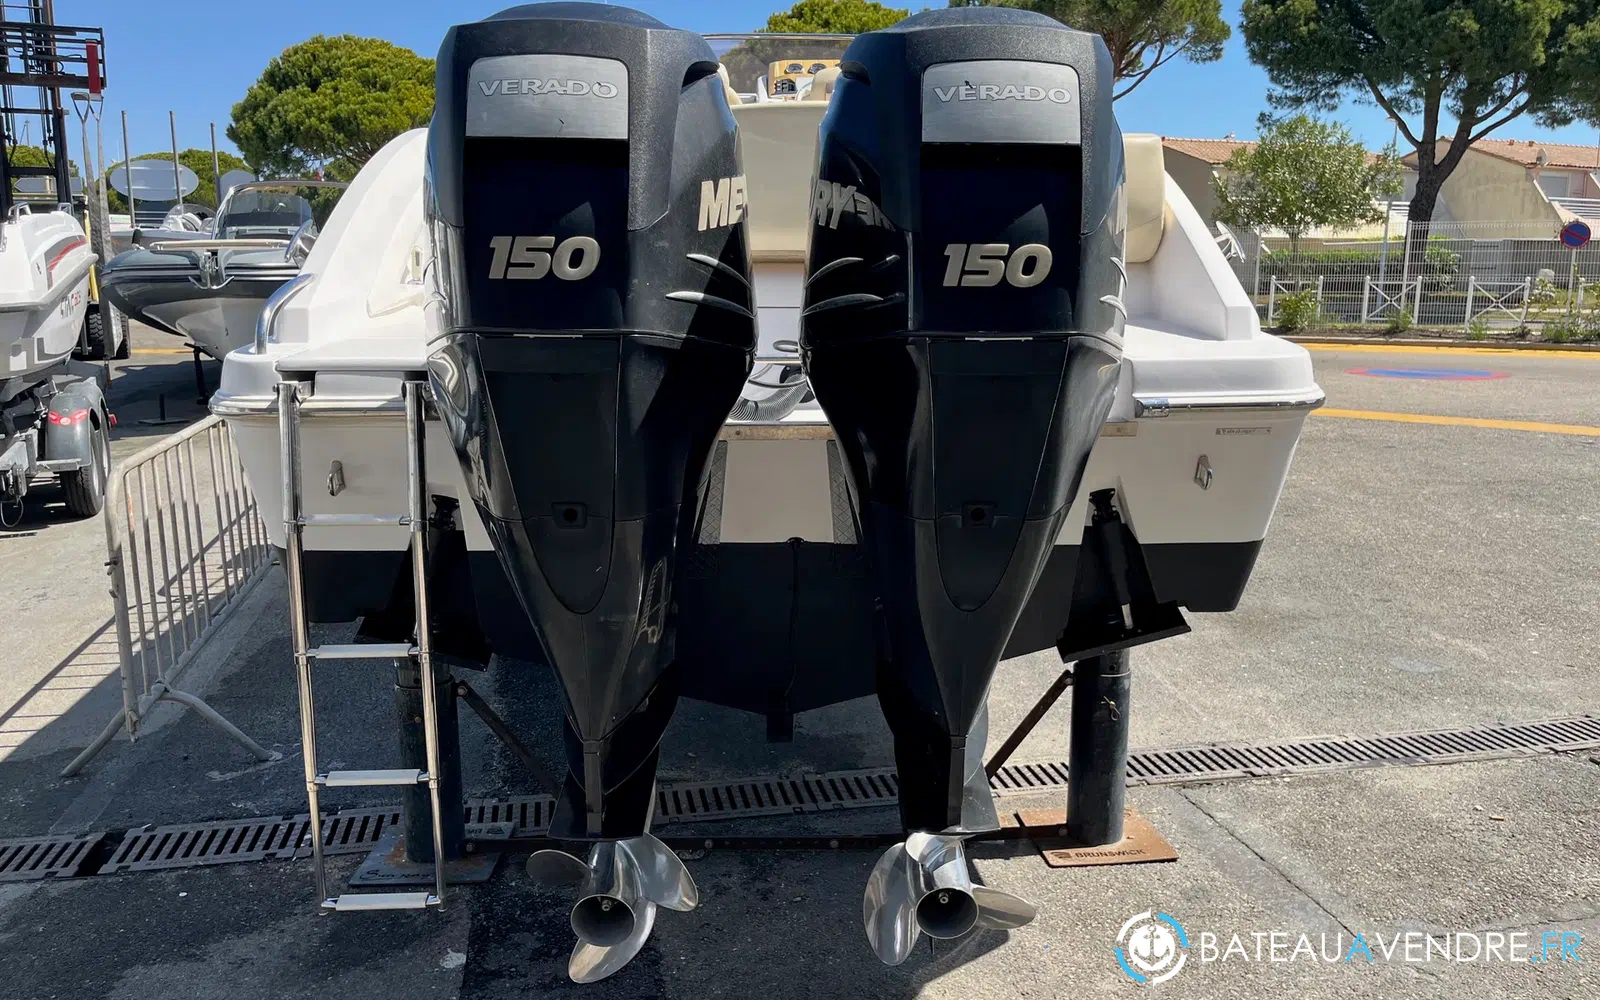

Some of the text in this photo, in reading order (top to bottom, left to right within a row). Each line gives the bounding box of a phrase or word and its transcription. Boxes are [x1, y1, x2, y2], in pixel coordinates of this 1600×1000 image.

[477, 79, 619, 99] VERADO
[932, 84, 1072, 104] VERADO
[488, 236, 601, 281] 150
[942, 243, 1053, 288] 150
[1074, 848, 1146, 858] BRUNSWICK
